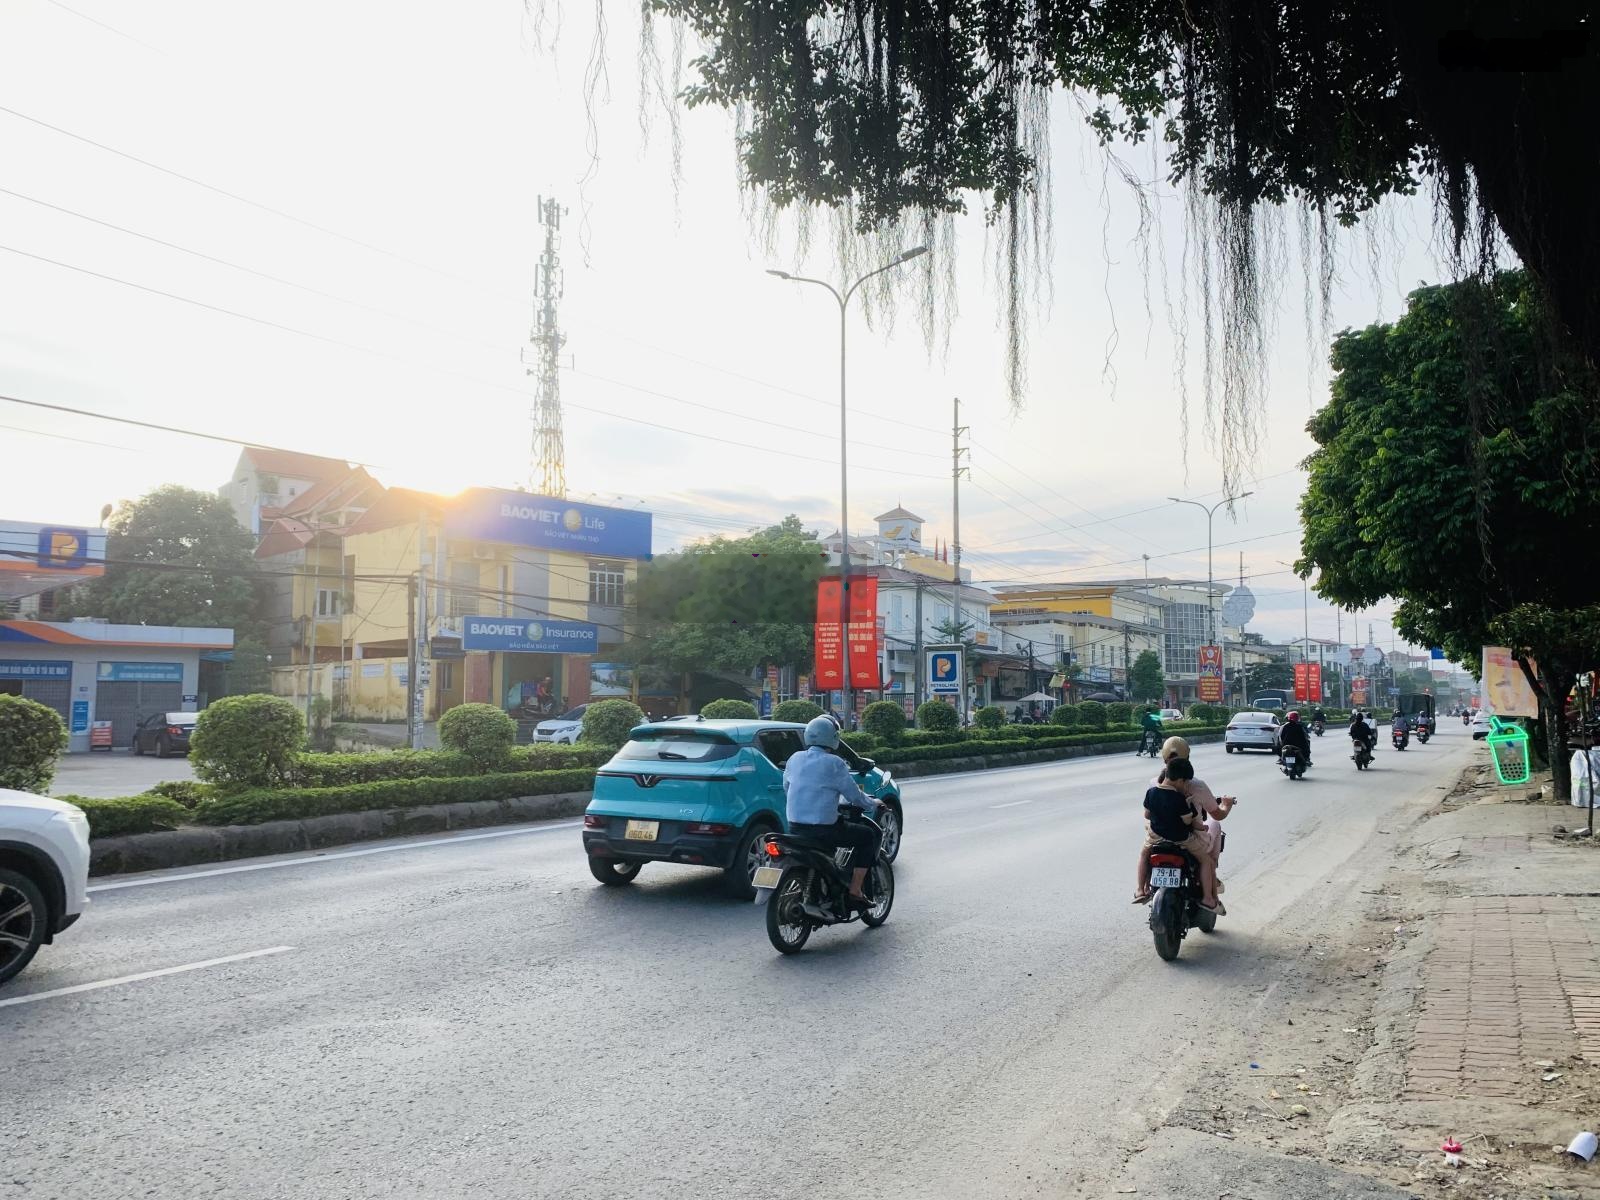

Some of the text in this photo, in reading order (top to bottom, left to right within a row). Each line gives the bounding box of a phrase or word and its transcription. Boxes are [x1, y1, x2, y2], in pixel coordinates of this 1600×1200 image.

[501, 504, 605, 530] BAOVIET Life
[470, 623, 594, 639] BAOVIET Insurance
